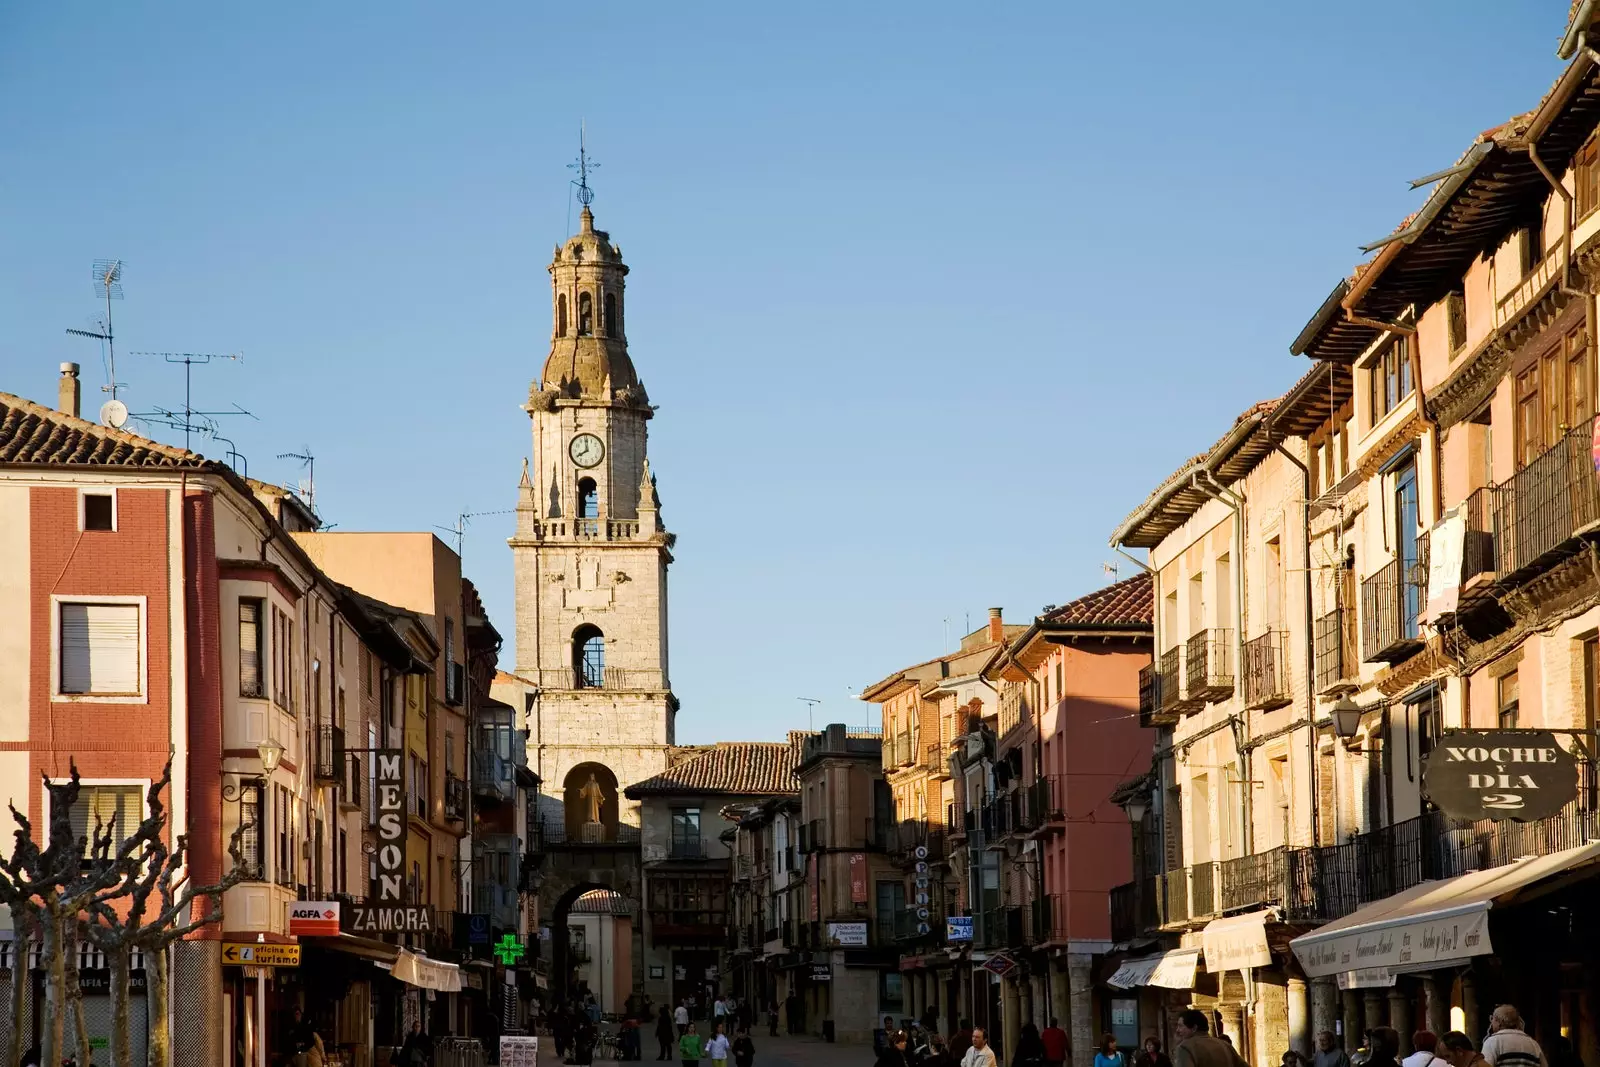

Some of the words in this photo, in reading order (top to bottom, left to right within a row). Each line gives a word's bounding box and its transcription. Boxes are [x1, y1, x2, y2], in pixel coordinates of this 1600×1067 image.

[1445, 747, 1557, 763] NOCHE
[1496, 764, 1505, 772] Y
[1482, 793, 1525, 809] 2
[379, 755, 402, 900] MESON
[916, 847, 929, 934] OPTICA
[292, 910, 320, 918] AGFA
[353, 908, 430, 931] ZAMORA
[255, 946, 284, 954] oficina
[255, 954, 298, 964] turismo
